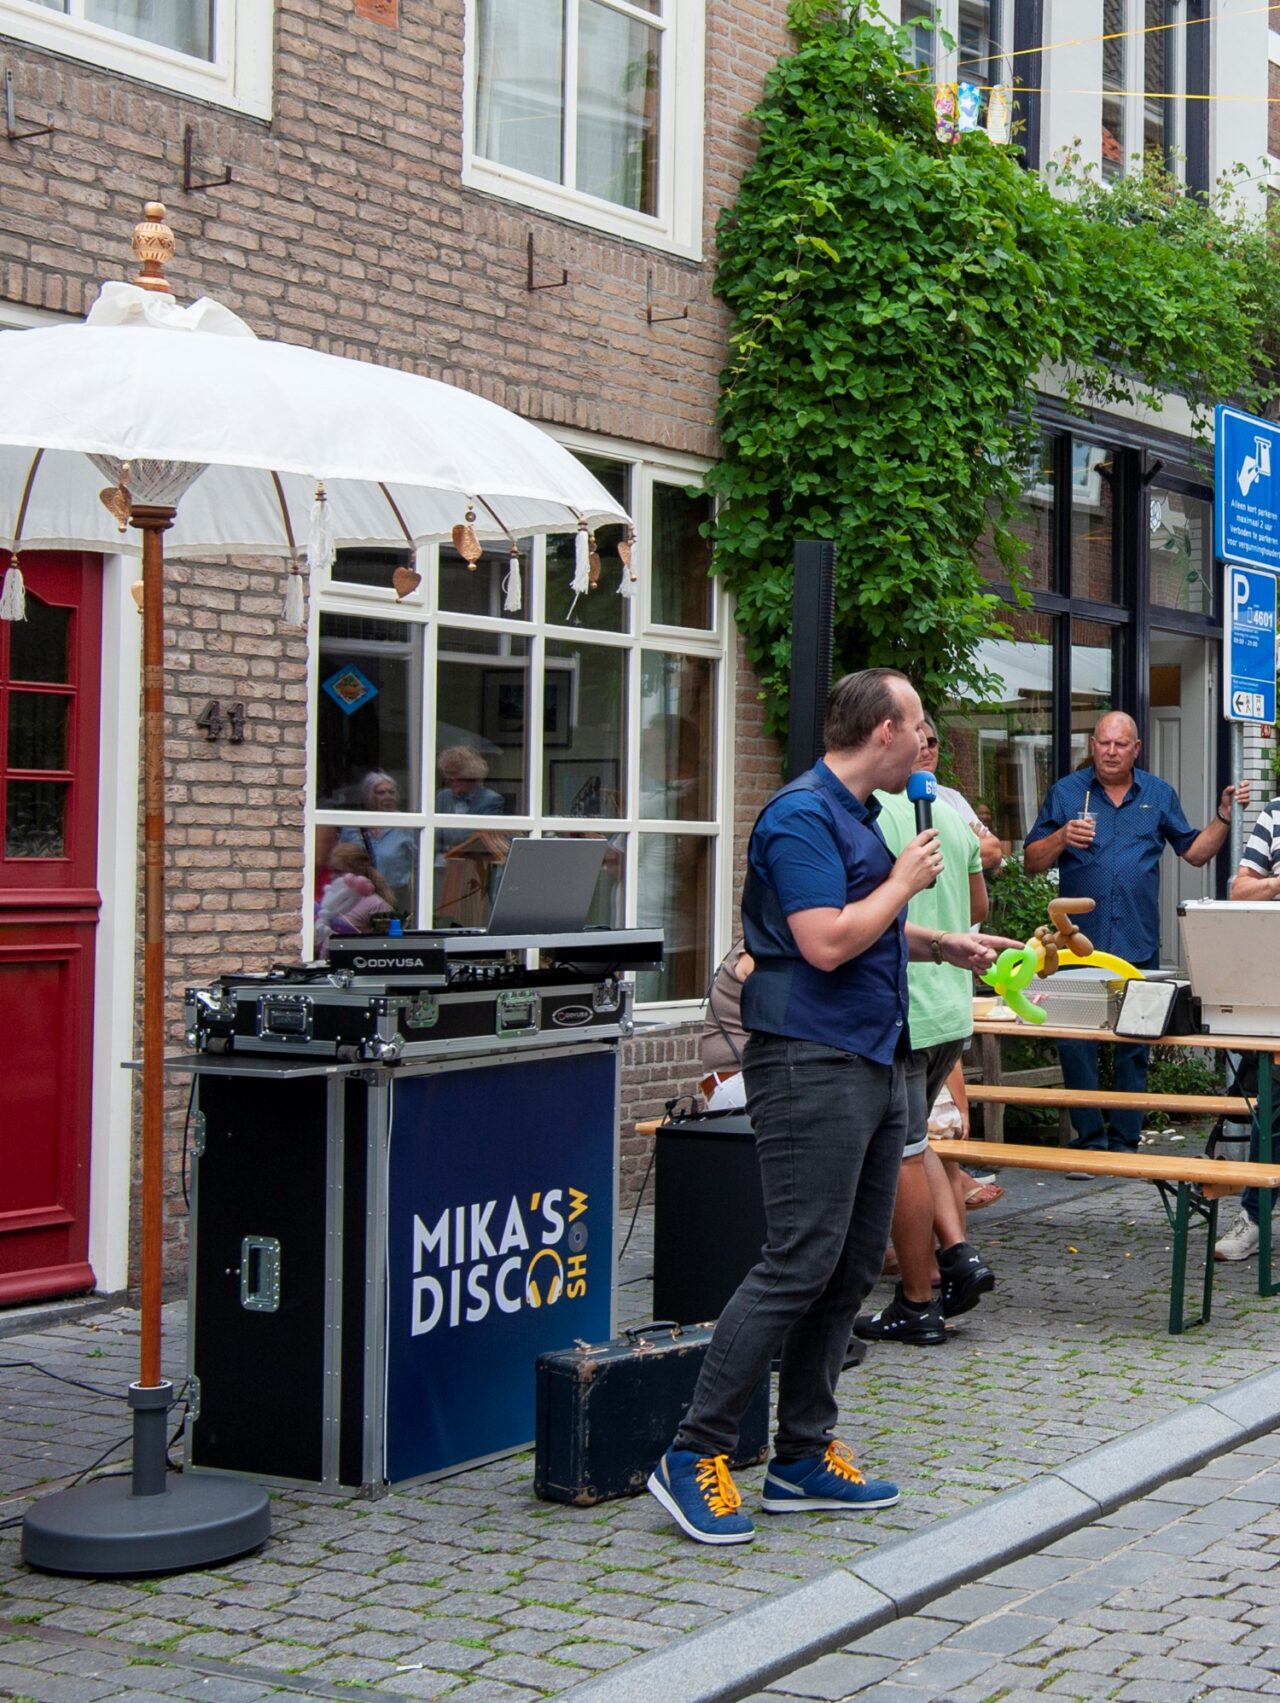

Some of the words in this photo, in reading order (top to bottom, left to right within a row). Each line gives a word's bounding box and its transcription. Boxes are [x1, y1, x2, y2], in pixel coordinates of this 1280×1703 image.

[1233, 573, 1250, 621] P
[1253, 609, 1273, 628] 4601
[196, 700, 245, 745] 41
[412, 1188, 565, 1274] MIKA'S
